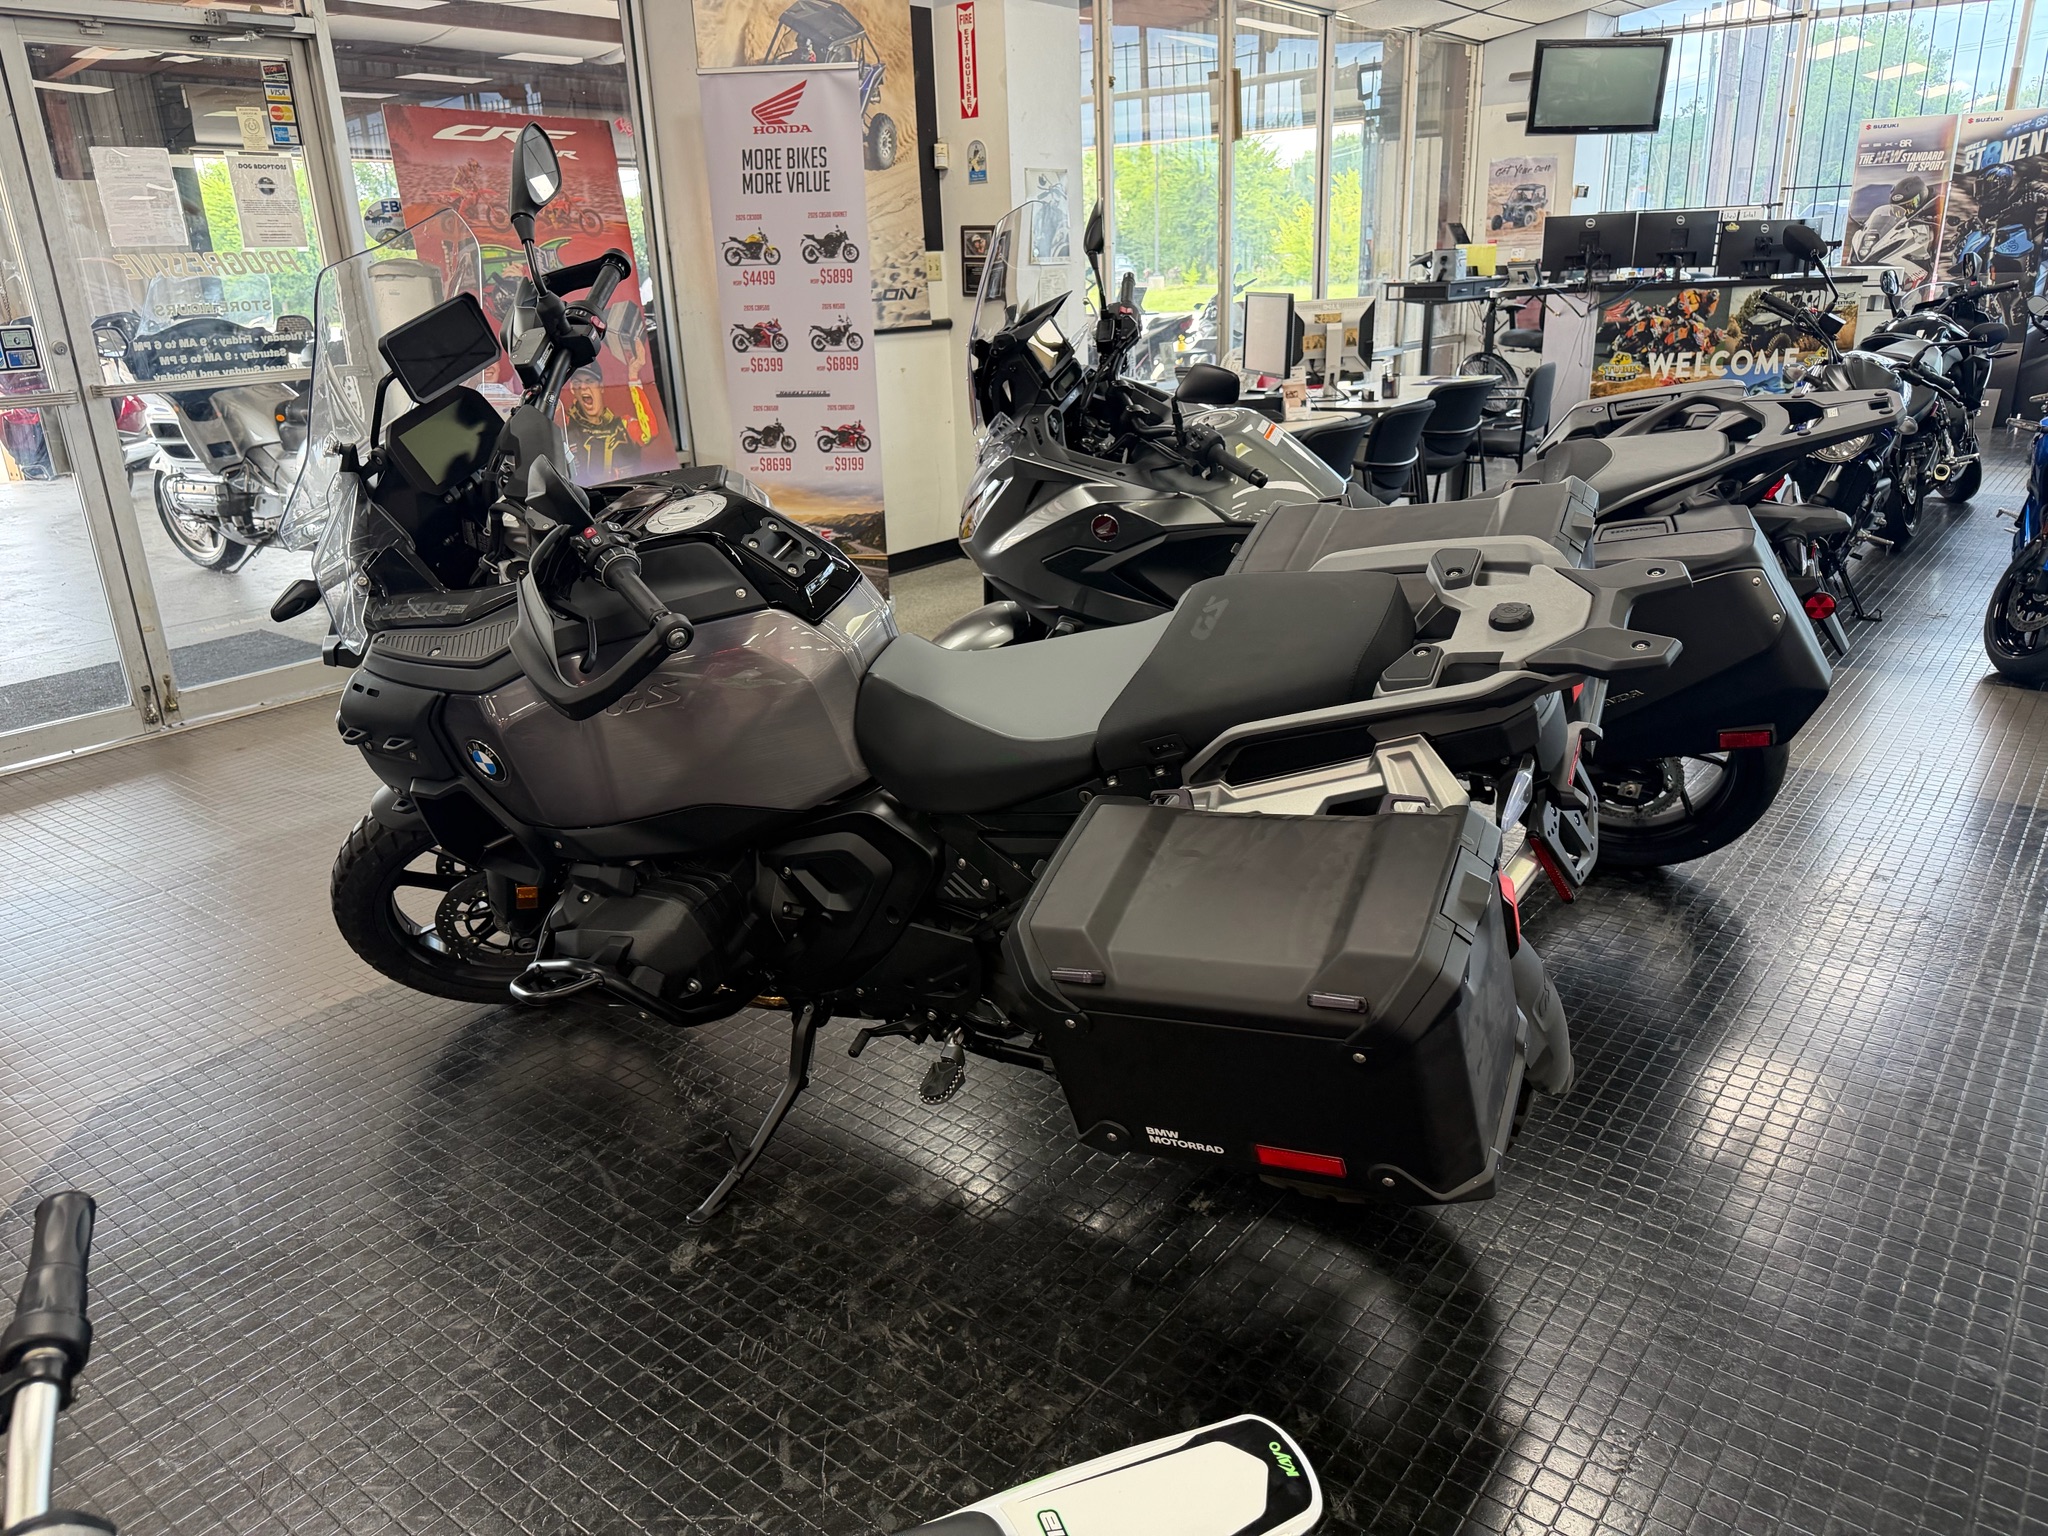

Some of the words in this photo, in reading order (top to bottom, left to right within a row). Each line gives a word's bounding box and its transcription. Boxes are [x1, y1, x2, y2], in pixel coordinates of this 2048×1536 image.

[959, 13, 973, 26] FIRE
[963, 28, 973, 110] EXTINGUISHER
[753, 124, 813, 135] HONDA
[742, 147, 782, 171] MORE
[786, 146, 828, 170] BIKES
[1858, 154, 1875, 165] THE
[1873, 149, 1905, 164] NEW
[1900, 150, 1945, 163] STANDARD
[1906, 161, 1918, 172] OF
[1917, 160, 1947, 172] SPORT
[742, 172, 782, 195] MORE
[786, 170, 831, 194] VALUE
[743, 270, 776, 287] $4499
[820, 268, 853, 285] $5899
[750, 357, 783, 373] $6399
[826, 356, 859, 372] $6899
[1649, 347, 1800, 379] WELCOME
[759, 457, 792, 473] $8699
[834, 456, 864, 472] $9199
[1145, 1126, 1179, 1139] BMW
[1148, 1134, 1225, 1155] MOTORRAD
